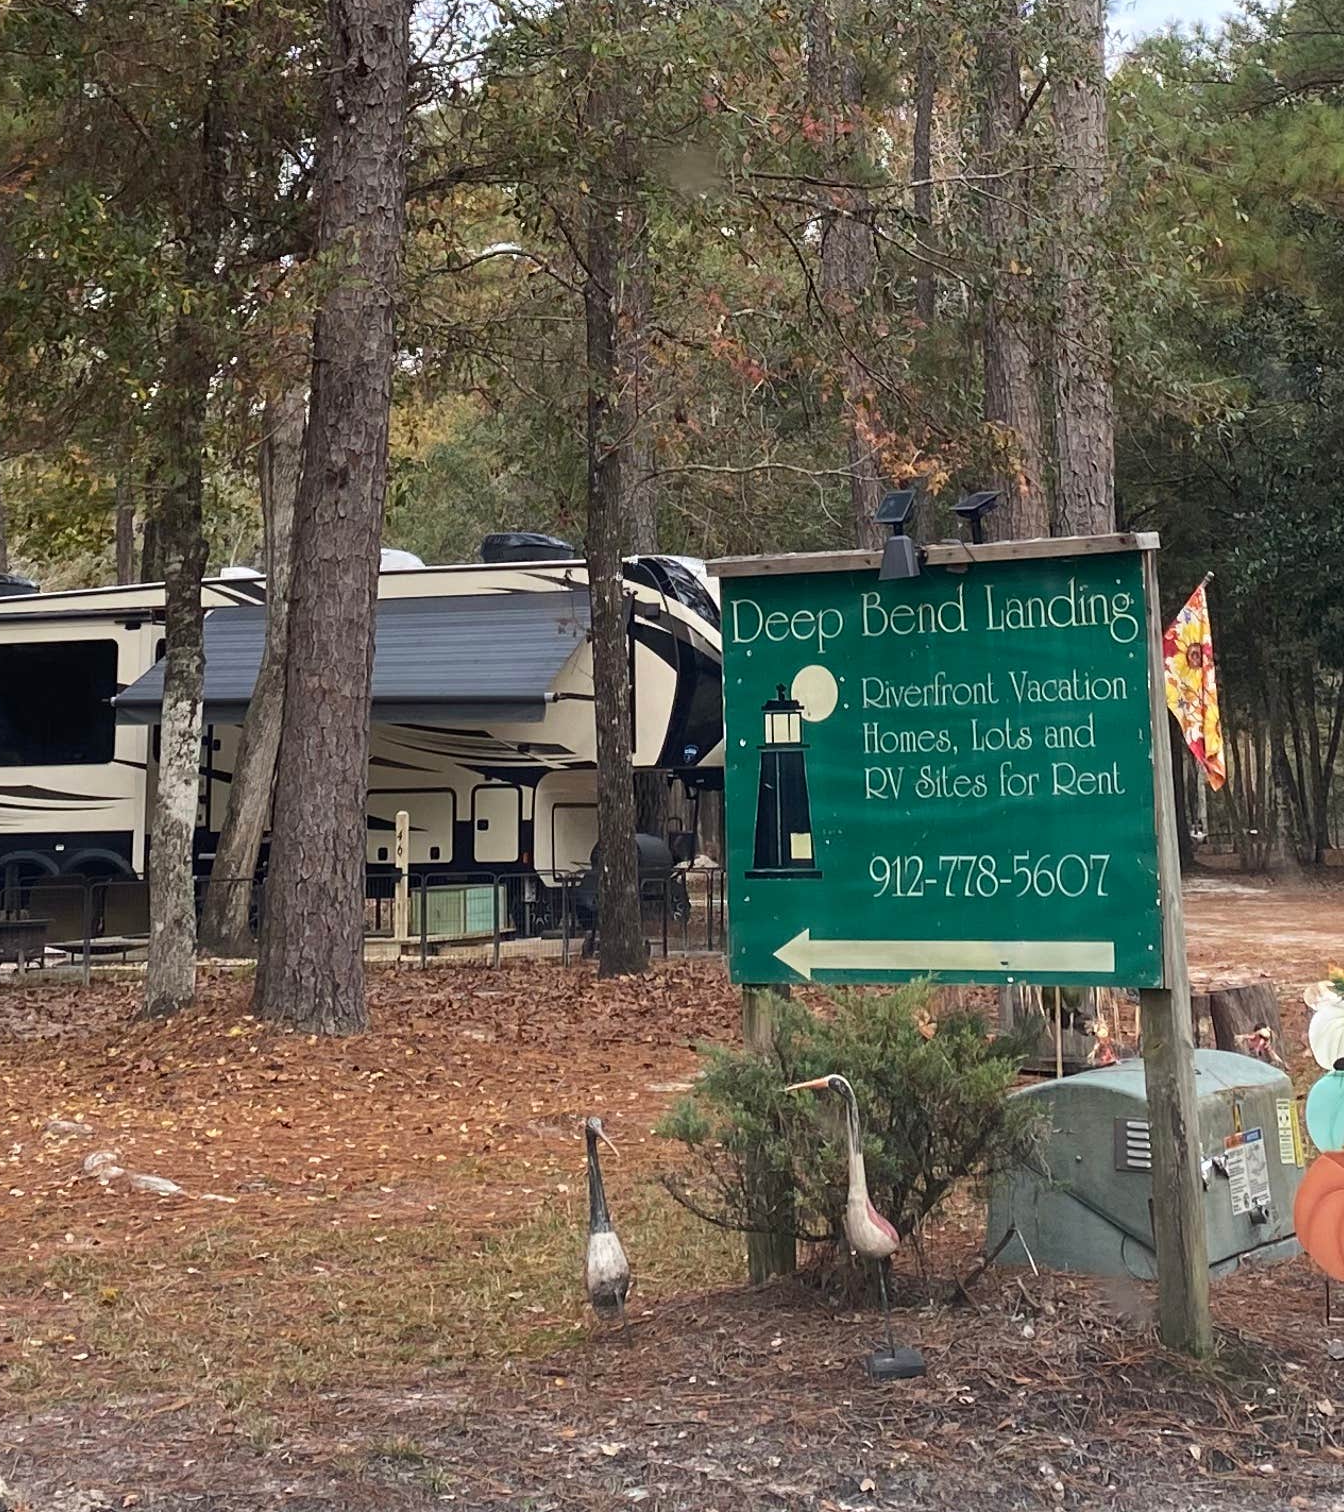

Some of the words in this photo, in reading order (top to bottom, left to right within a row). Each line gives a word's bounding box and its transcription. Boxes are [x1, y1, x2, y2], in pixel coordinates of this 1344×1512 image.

[730, 599, 844, 653] Deep
[861, 583, 968, 637] Bend
[985, 577, 1138, 644] Landing
[861, 672, 999, 709] Riverfront
[1009, 665, 1128, 703] Vacation
[863, 722, 958, 755] Homes,
[971, 718, 1033, 752] Lots
[1044, 713, 1096, 749] and
[864, 767, 904, 800] RV
[914, 762, 988, 798] Sites
[1000, 763, 1040, 797] for
[1052, 761, 1126, 796] Rent
[868, 850, 1111, 898] 912-778-5607
